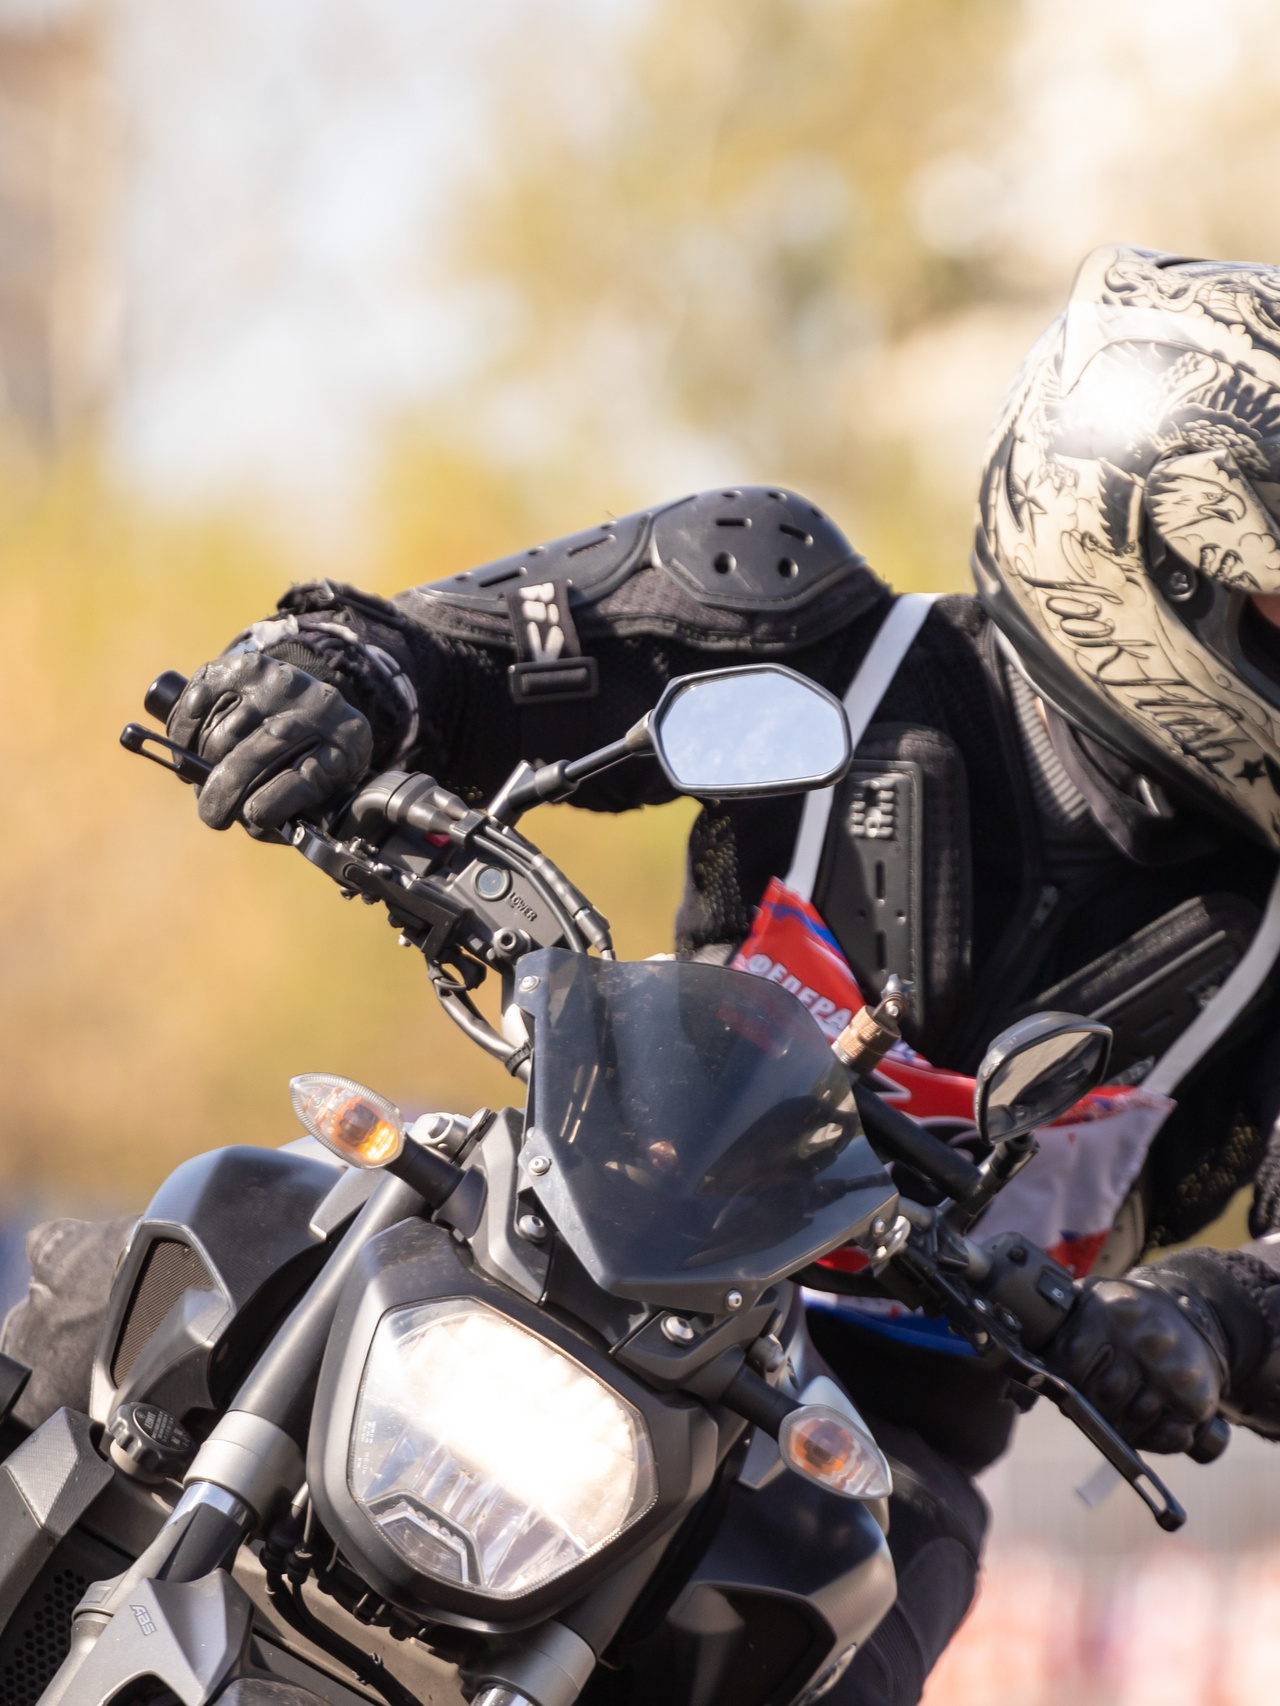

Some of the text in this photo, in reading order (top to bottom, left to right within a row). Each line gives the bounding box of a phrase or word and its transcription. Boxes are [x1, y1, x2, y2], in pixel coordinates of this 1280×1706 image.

[509, 891, 538, 922] LOWER
[747, 953, 853, 1040] ФЕДЕРА
[129, 1605, 157, 1637] ABS
